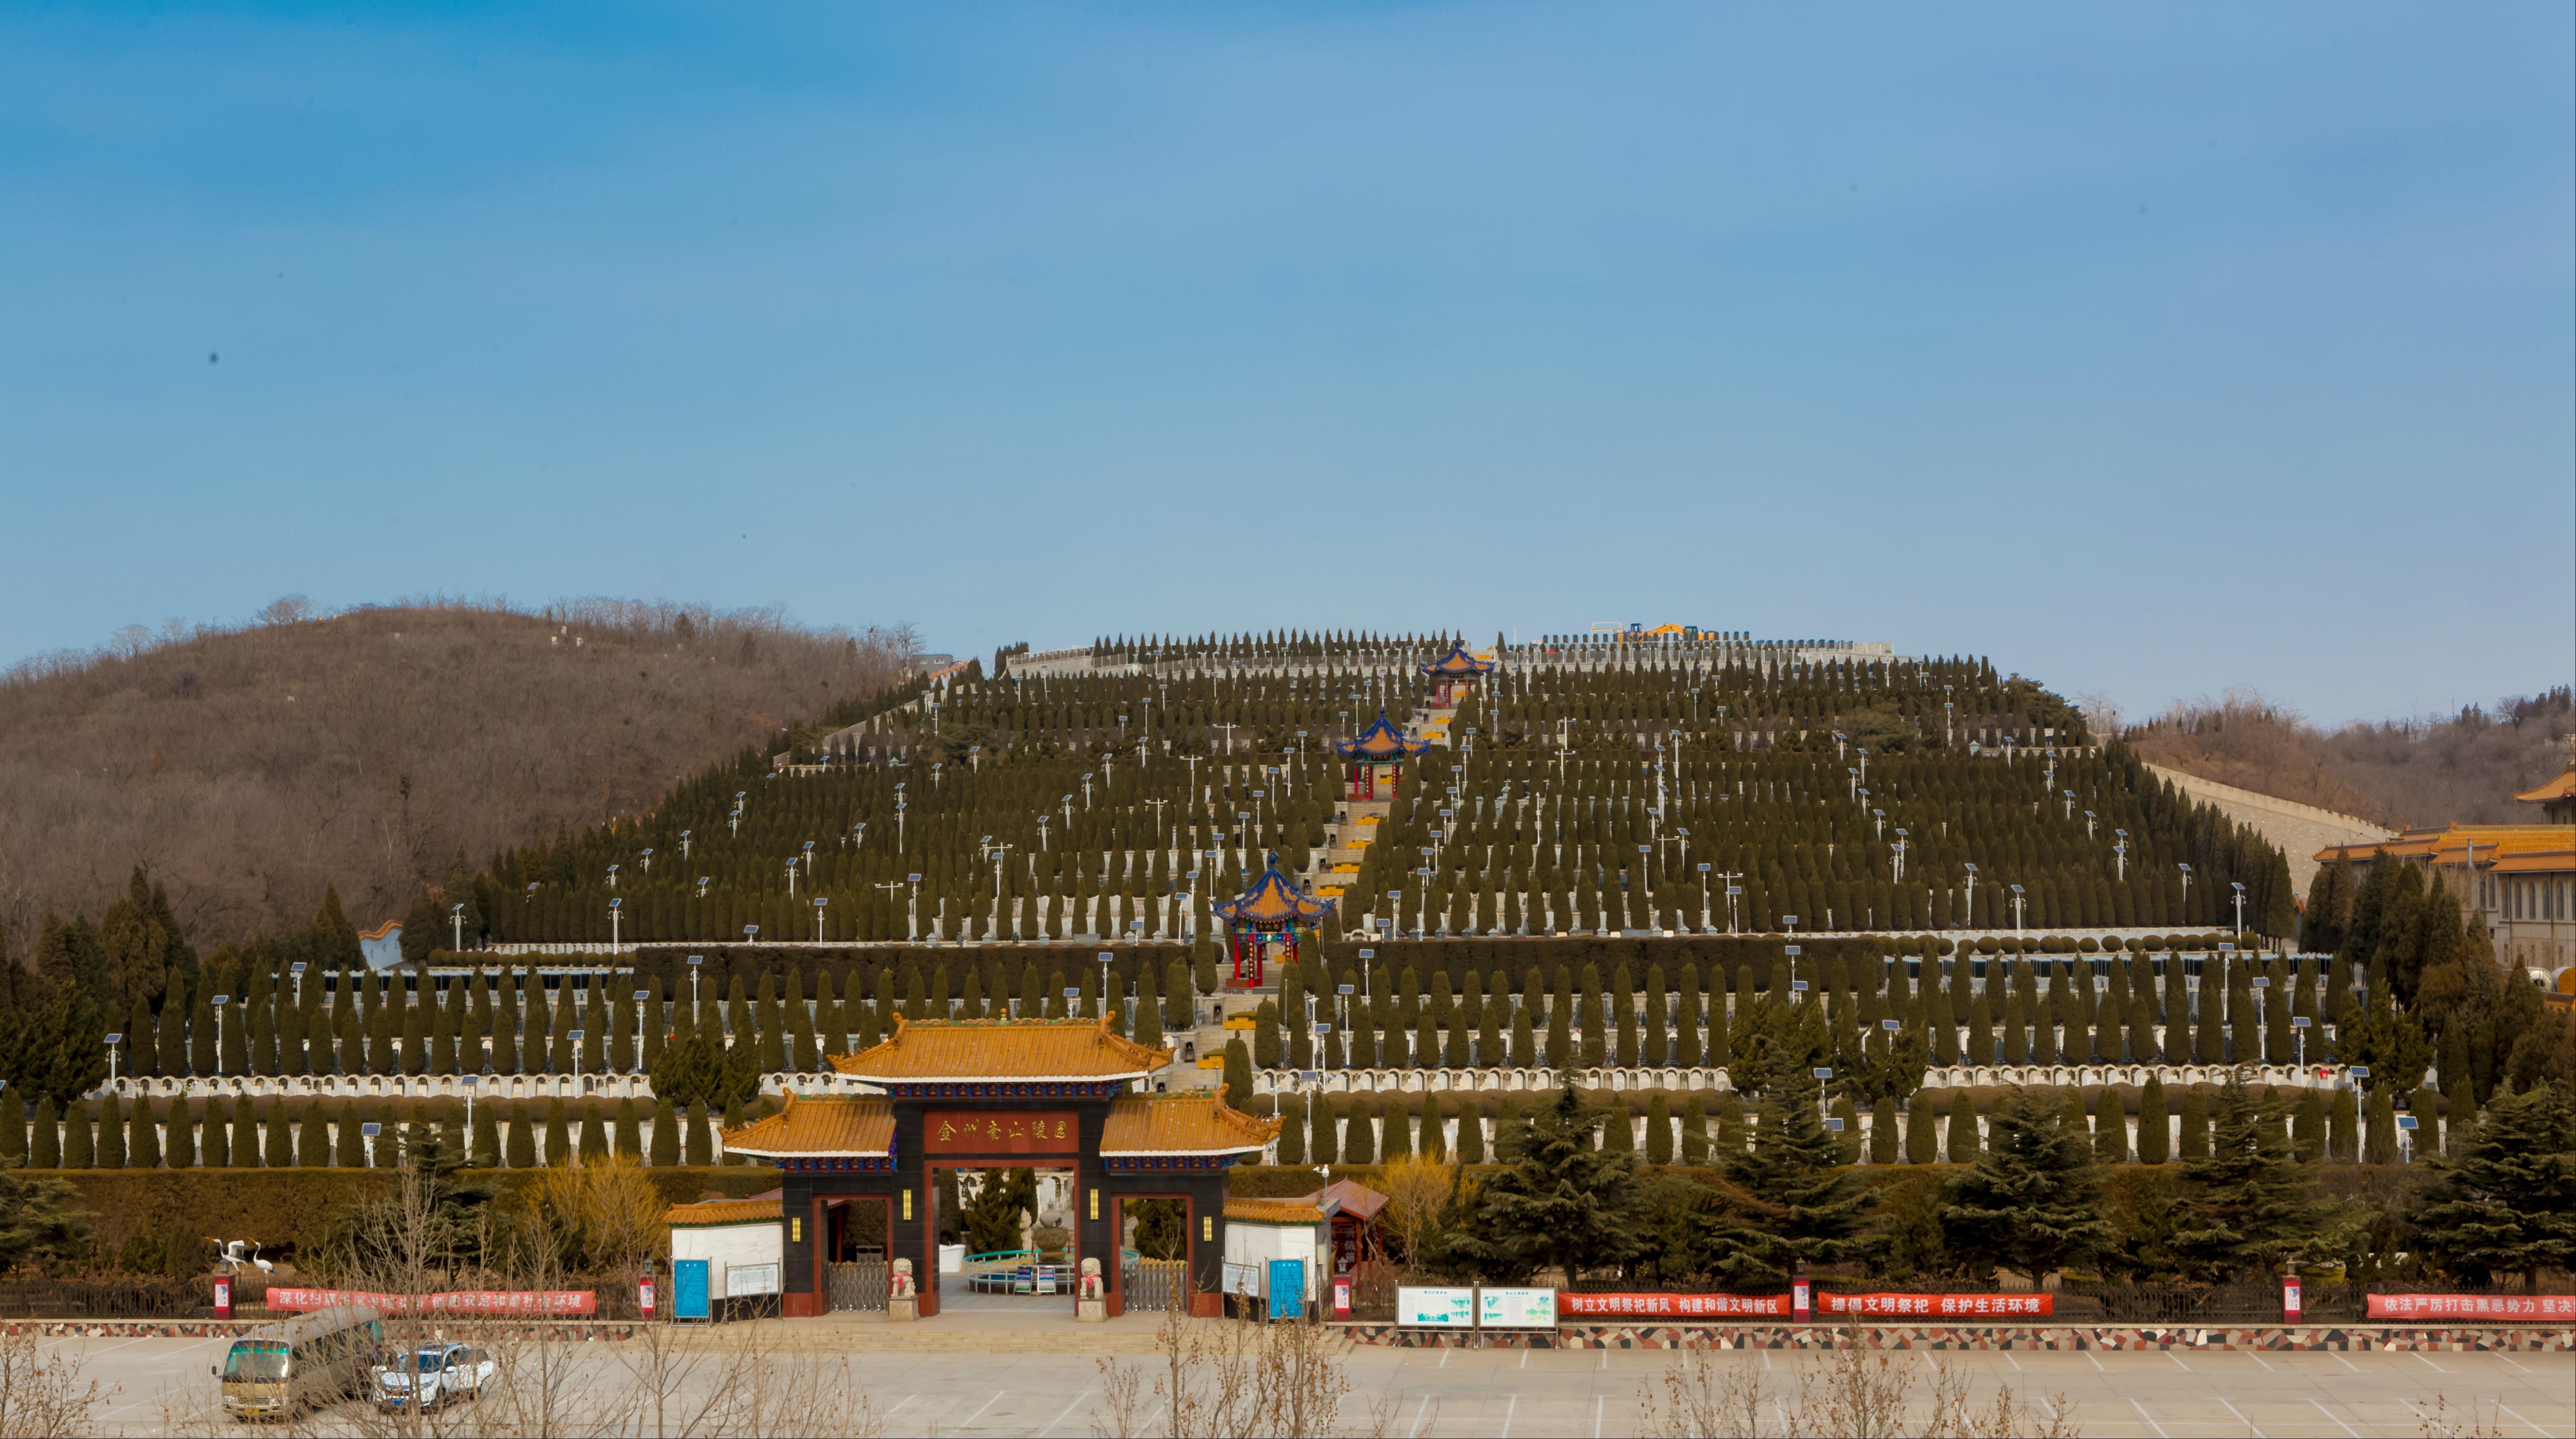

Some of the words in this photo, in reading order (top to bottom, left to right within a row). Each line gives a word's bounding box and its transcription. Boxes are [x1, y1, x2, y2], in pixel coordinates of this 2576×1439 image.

[1571, 1297, 1670, 1313] 树立文明祭祀新风
[1679, 1297, 1778, 1314] 构建和谐文明新区
[1831, 1297, 1929, 1313] 提倡文明祭祀
[1941, 1298, 2040, 1313] 保护生活环境
[2384, 1297, 2535, 1313] 依法严厉打击黑恶势力
[2543, 1299, 2576, 1313] 坚决
